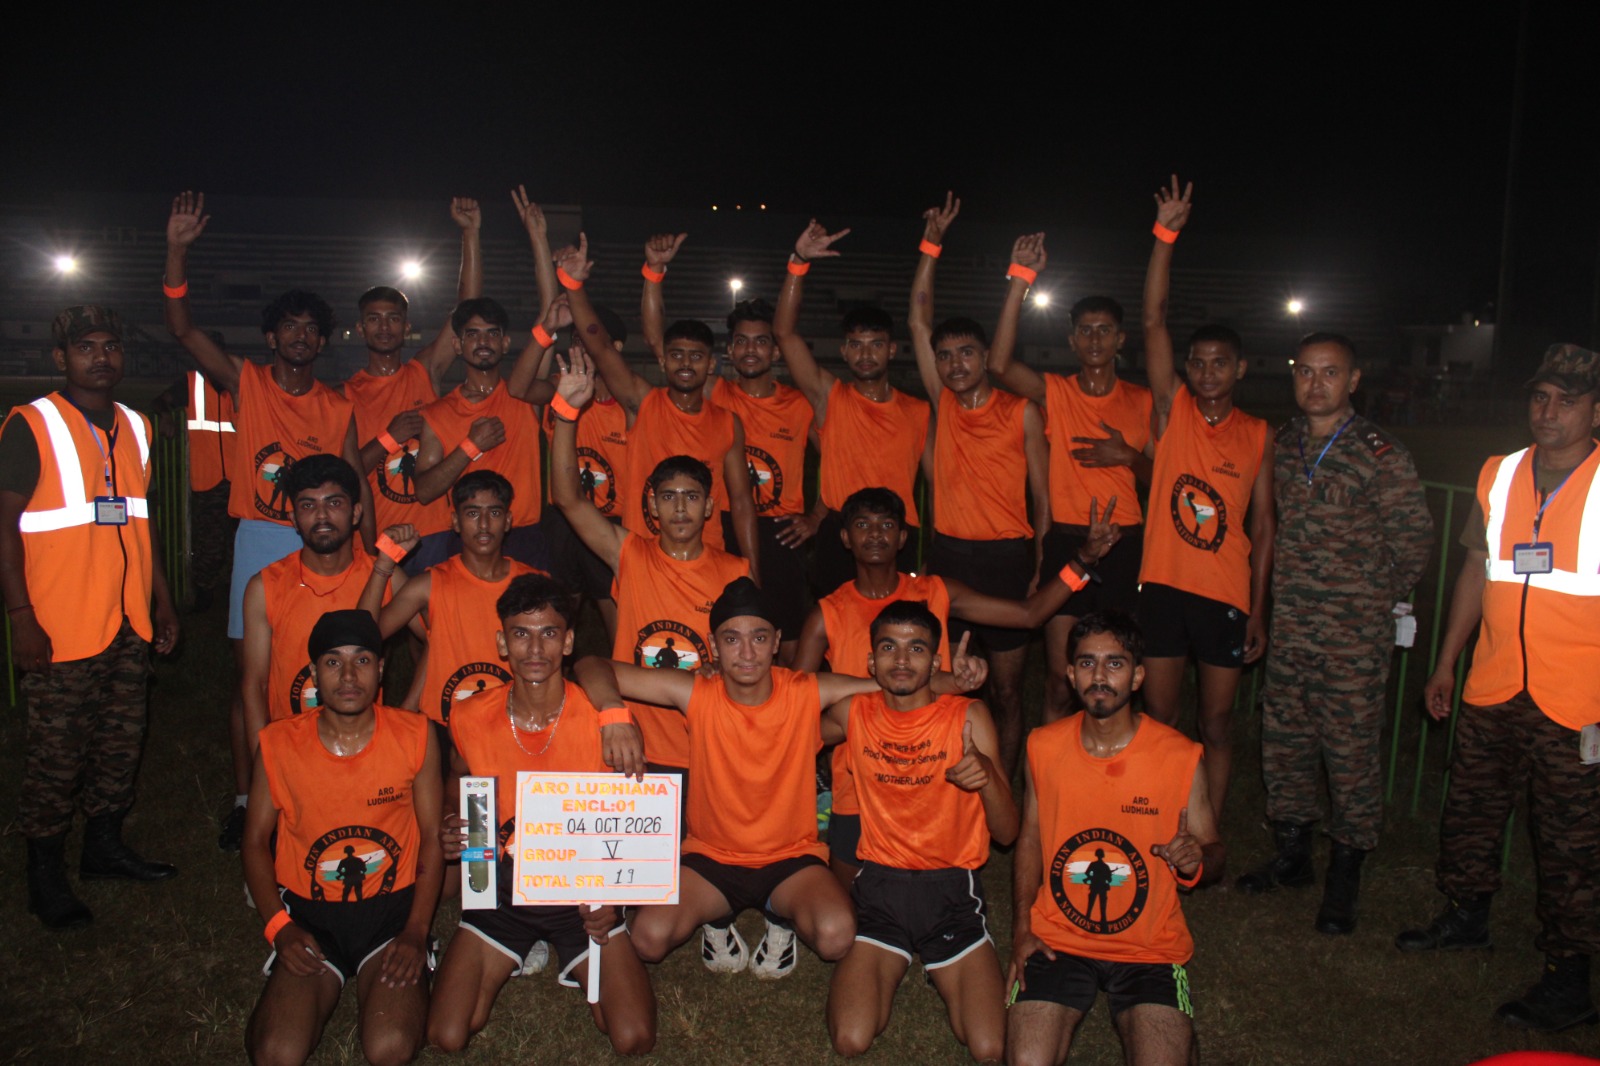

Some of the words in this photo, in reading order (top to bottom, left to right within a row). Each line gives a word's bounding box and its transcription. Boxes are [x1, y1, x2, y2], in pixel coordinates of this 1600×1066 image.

[652, 621, 692, 637] INDIAN
[292, 674, 305, 700] JOIN
[443, 675, 460, 702] JOIN
[461, 664, 502, 676] INDIAN
[378, 786, 394, 797] ARO
[531, 782, 570, 795] ARO
[575, 782, 668, 796] LUDHIANA
[562, 799, 636, 813] ENCL:01
[1132, 796, 1149, 806] ARO
[1121, 804, 1159, 816] LUDHIANA
[524, 822, 564, 836] DATE
[567, 817, 586, 834] 04
[595, 817, 621, 834] OCT
[625, 816, 662, 834] 2026
[321, 828, 373, 846] INDIAN
[523, 849, 577, 862] GROUP
[1051, 846, 1071, 877] JOIN
[1075, 830, 1124, 846] INDIAN
[1128, 851, 1148, 890] ARMY
[522, 875, 570, 888] TOTAL
[575, 875, 605, 888] STR
[1107, 914, 1135, 933] PRIDE
